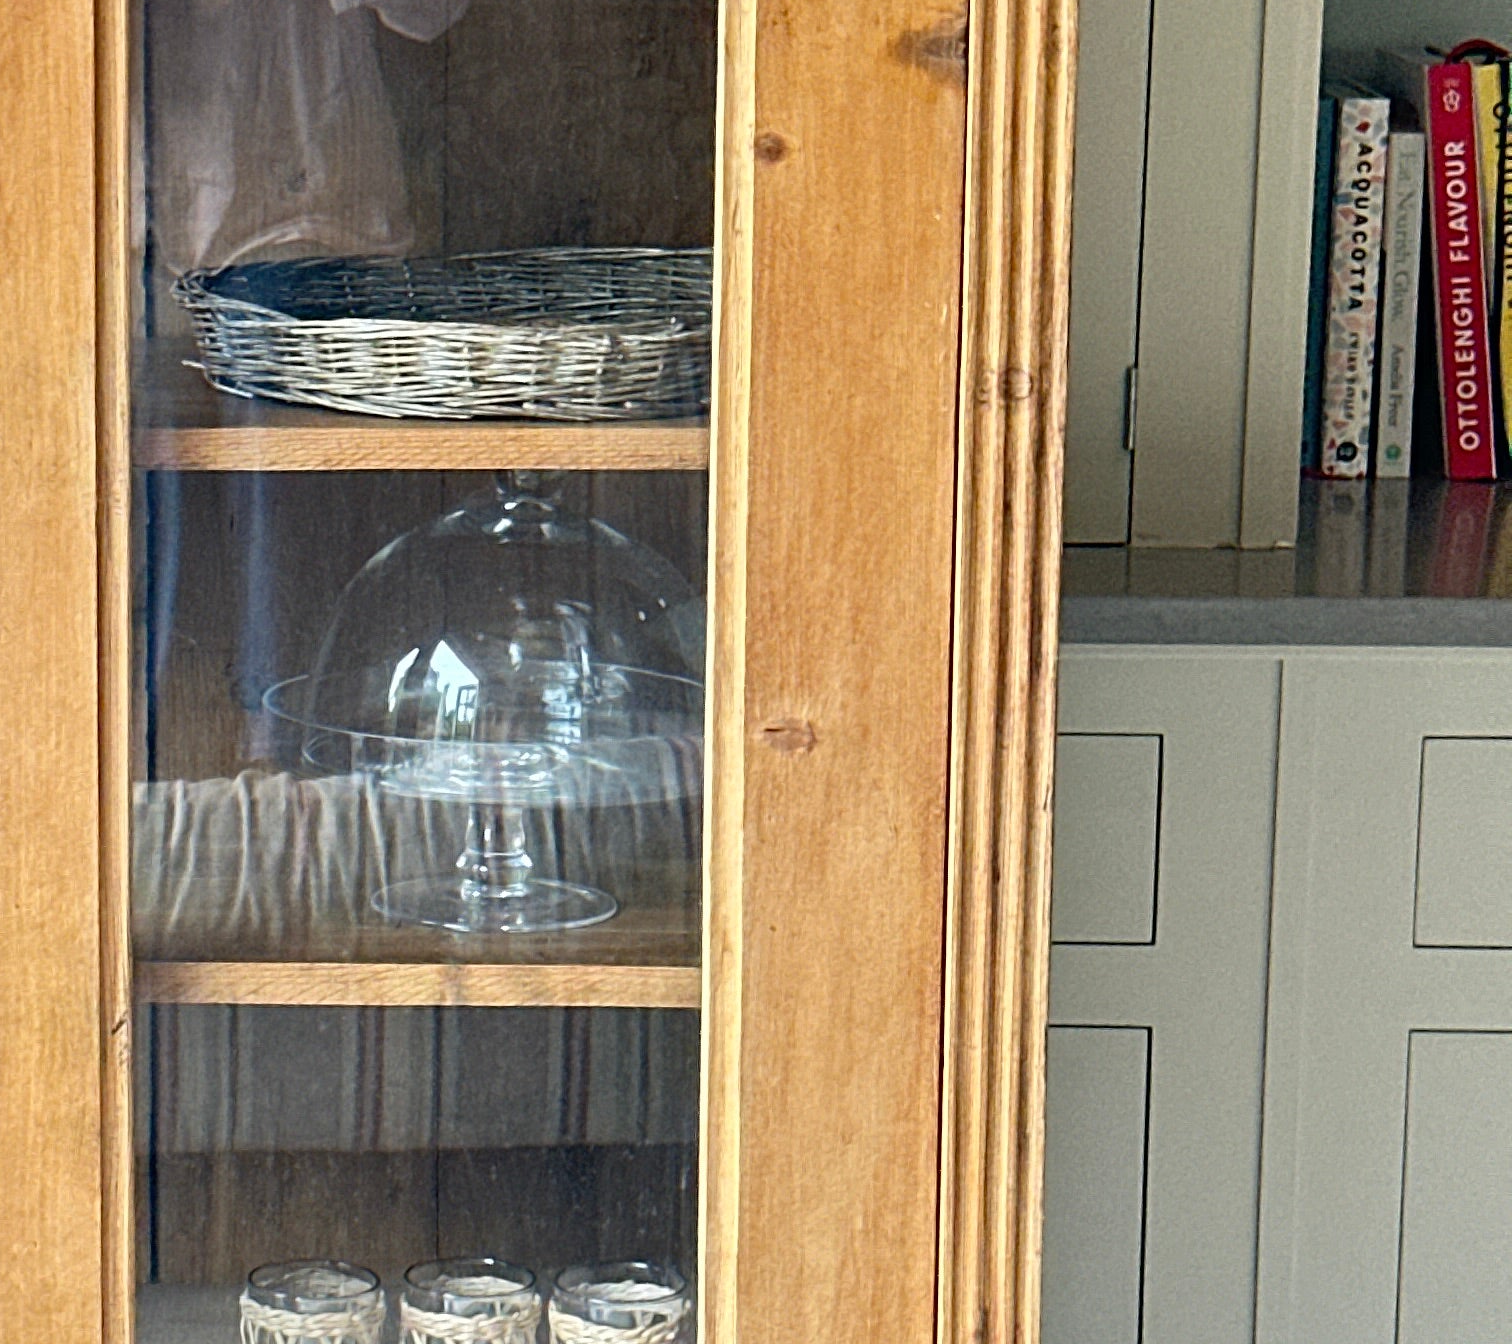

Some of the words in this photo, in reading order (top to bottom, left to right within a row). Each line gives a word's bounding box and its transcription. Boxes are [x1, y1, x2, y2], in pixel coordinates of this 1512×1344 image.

[1348, 143, 1374, 311] ACQUACOTTA
[1444, 140, 1470, 262] FLAVOUR
[1450, 276, 1481, 452] OTTOLENGHI
